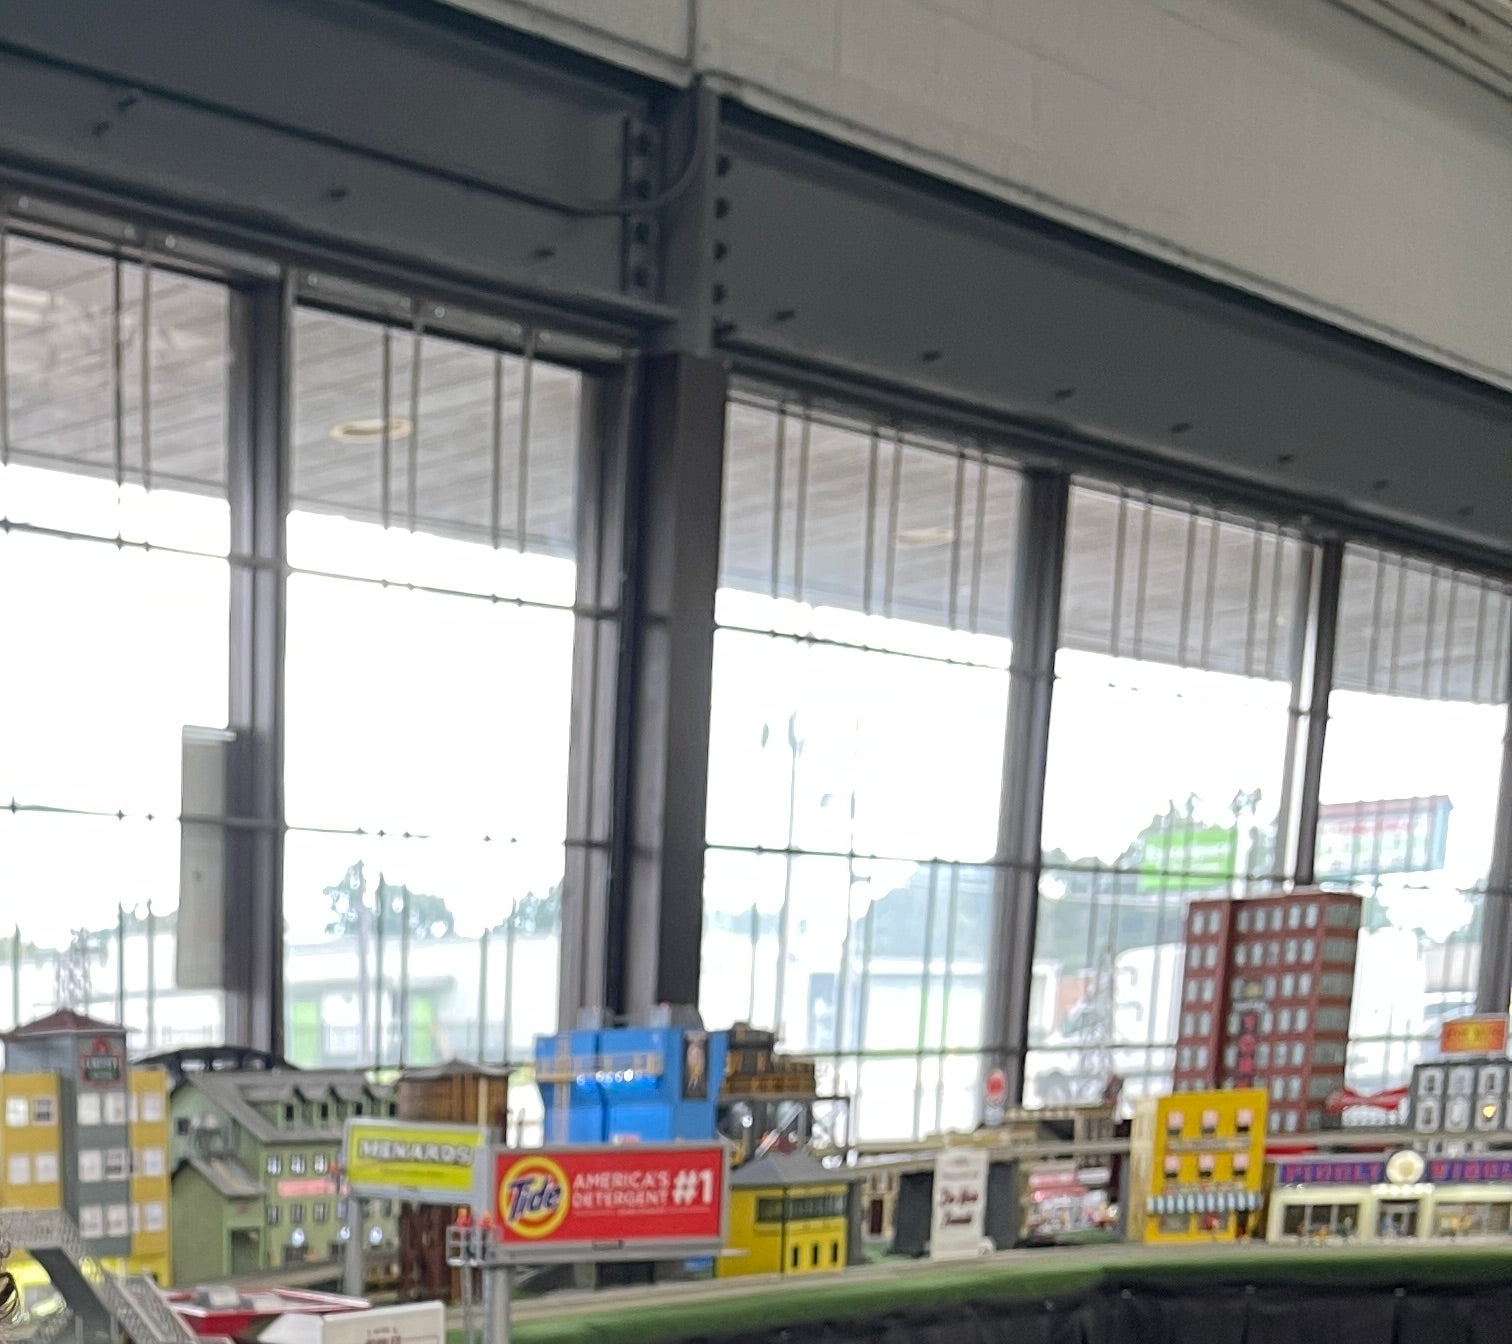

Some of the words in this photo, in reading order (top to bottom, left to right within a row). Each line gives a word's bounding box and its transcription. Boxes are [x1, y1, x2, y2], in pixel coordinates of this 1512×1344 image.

[358, 1138, 475, 1167] MENARDS
[573, 1169, 670, 1190] AMERICA'S
[671, 1168, 713, 1206] #1
[507, 1172, 562, 1225] Tide
[572, 1190, 669, 1209] DETERGENT
